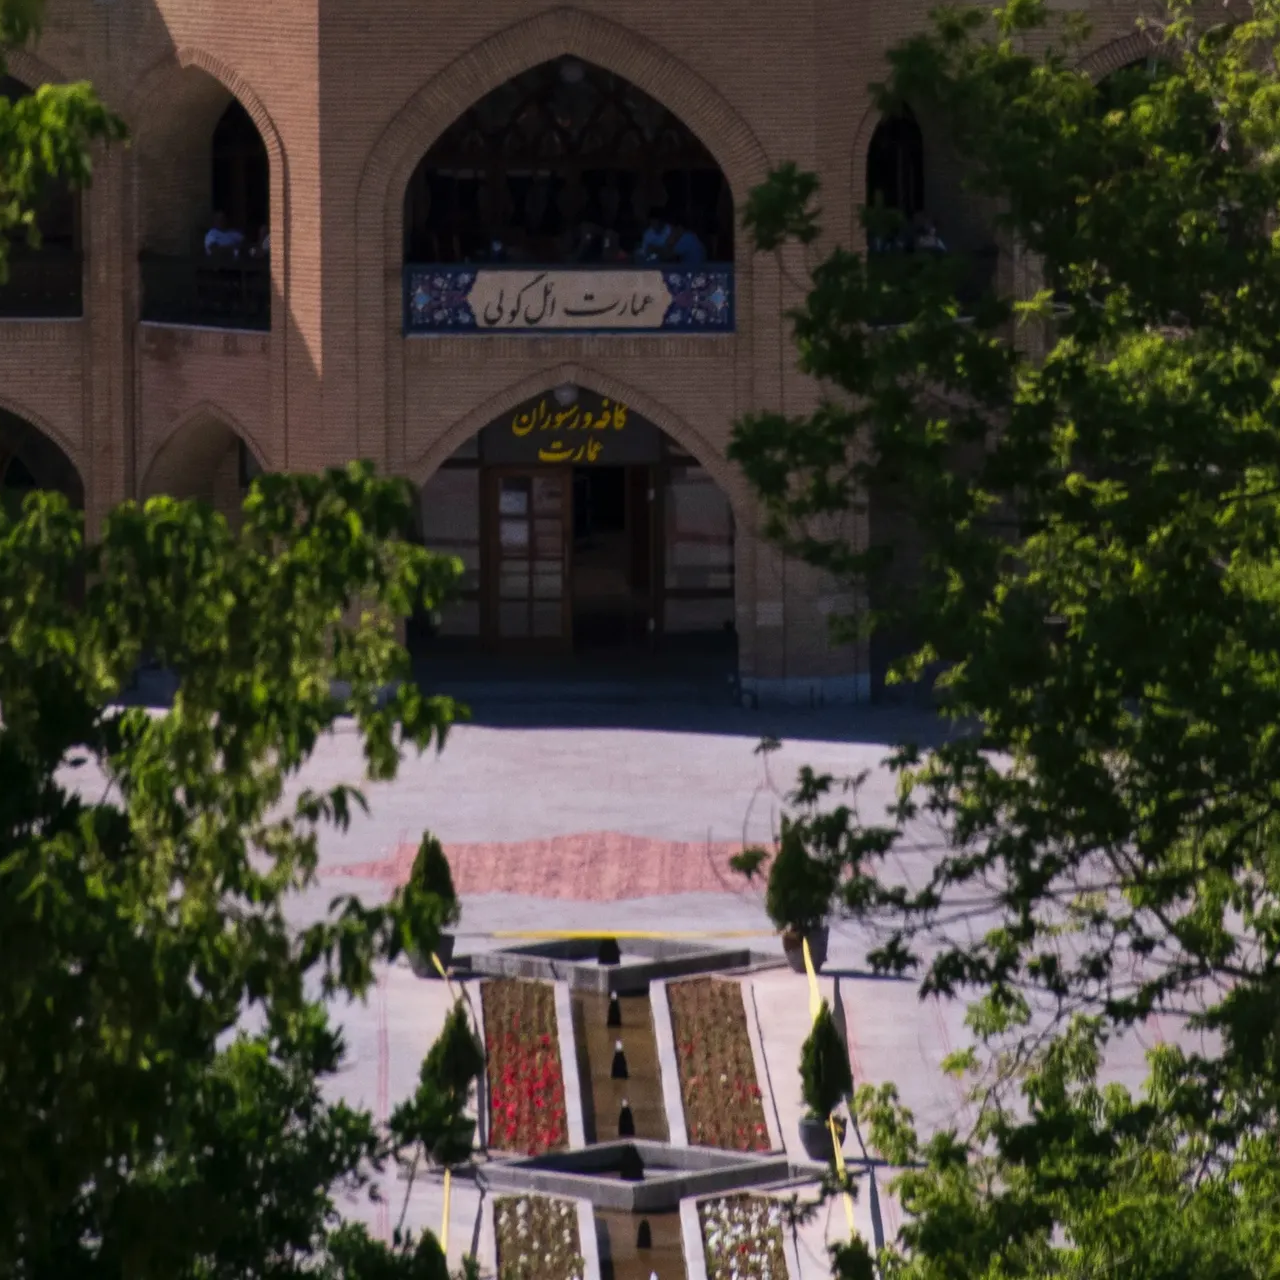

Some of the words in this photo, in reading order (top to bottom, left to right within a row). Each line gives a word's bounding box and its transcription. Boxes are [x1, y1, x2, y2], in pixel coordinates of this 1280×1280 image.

[563, 291, 654, 317] عمارت
[579, 411, 593, 430] و
[592, 398, 628, 430] کافه
[538, 434, 604, 462] عمارت
